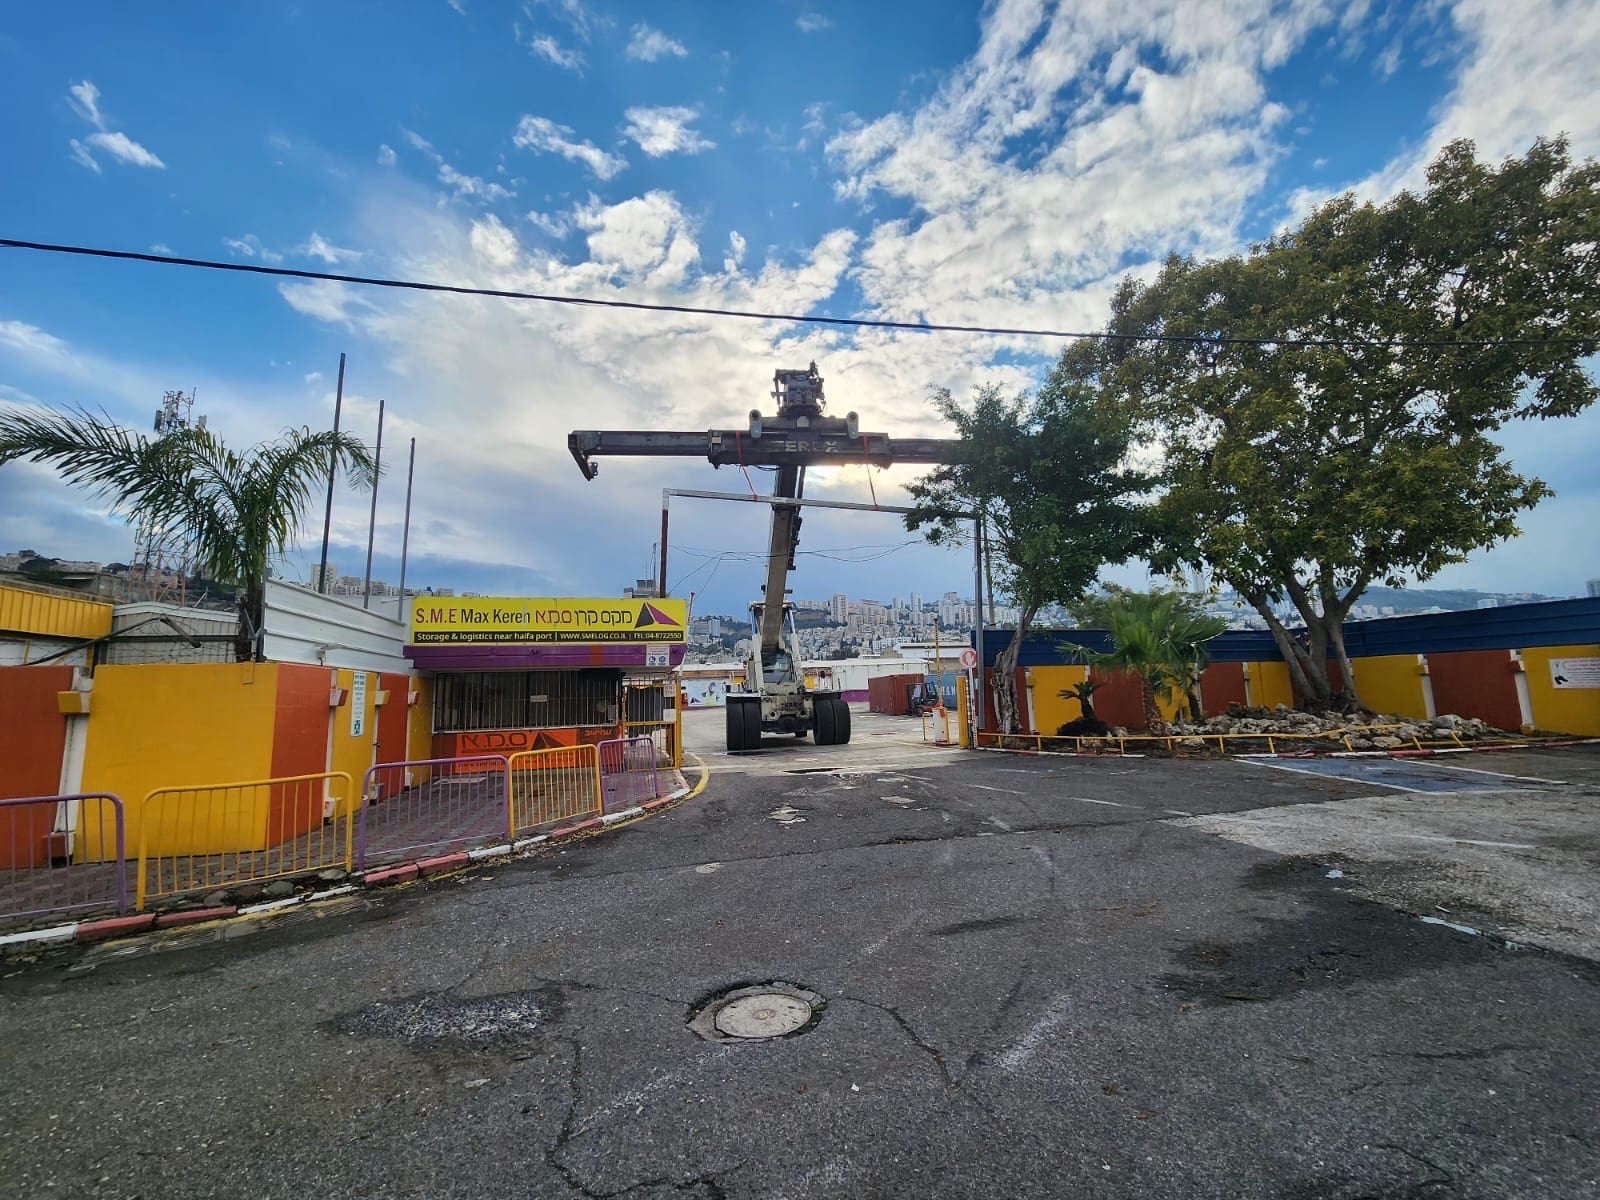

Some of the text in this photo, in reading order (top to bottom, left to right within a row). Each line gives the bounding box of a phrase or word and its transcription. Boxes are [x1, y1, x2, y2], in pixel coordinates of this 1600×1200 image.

[415, 607, 531, 624] S.M.E Max Keren
[574, 610, 598, 627] קרן
[600, 610, 633, 627] מקס
[417, 632, 450, 642] Storage
[460, 632, 493, 642] logistics
[514, 632, 534, 640] haifa
[535, 633, 553, 642] port
